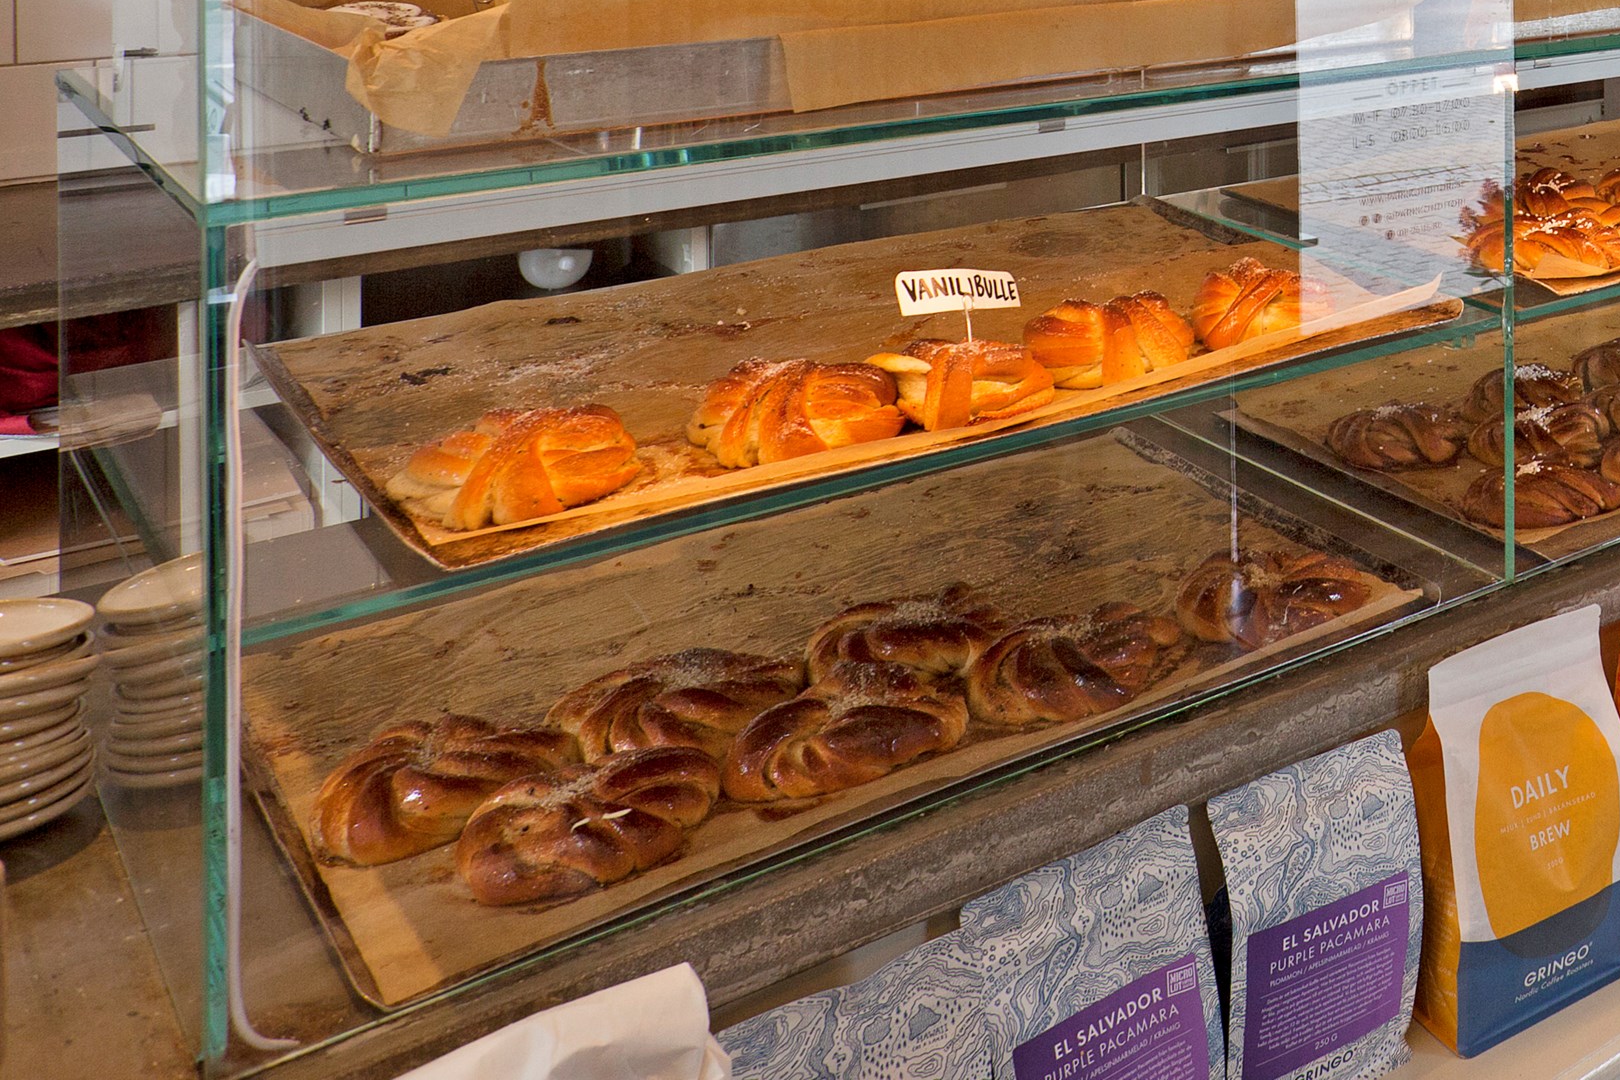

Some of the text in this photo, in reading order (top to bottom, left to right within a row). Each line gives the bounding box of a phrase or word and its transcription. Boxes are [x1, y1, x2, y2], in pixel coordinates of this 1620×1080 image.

[1510, 765, 1569, 809] DAILY
[1529, 819, 1571, 851] BREW
[1269, 915, 1391, 975] PURPLE PACAMARA
[1282, 899, 1380, 952] EL SALVADOR
[1269, 969, 1303, 988] PLOMMON
[1515, 959, 1594, 1004] Nordic Coffee Roasters
[1524, 944, 1590, 987] GRINGO
[1053, 1039, 1073, 1060] EL
[1077, 987, 1164, 1048] SALVADOR
[1099, 1004, 1179, 1057] PACAMARA
